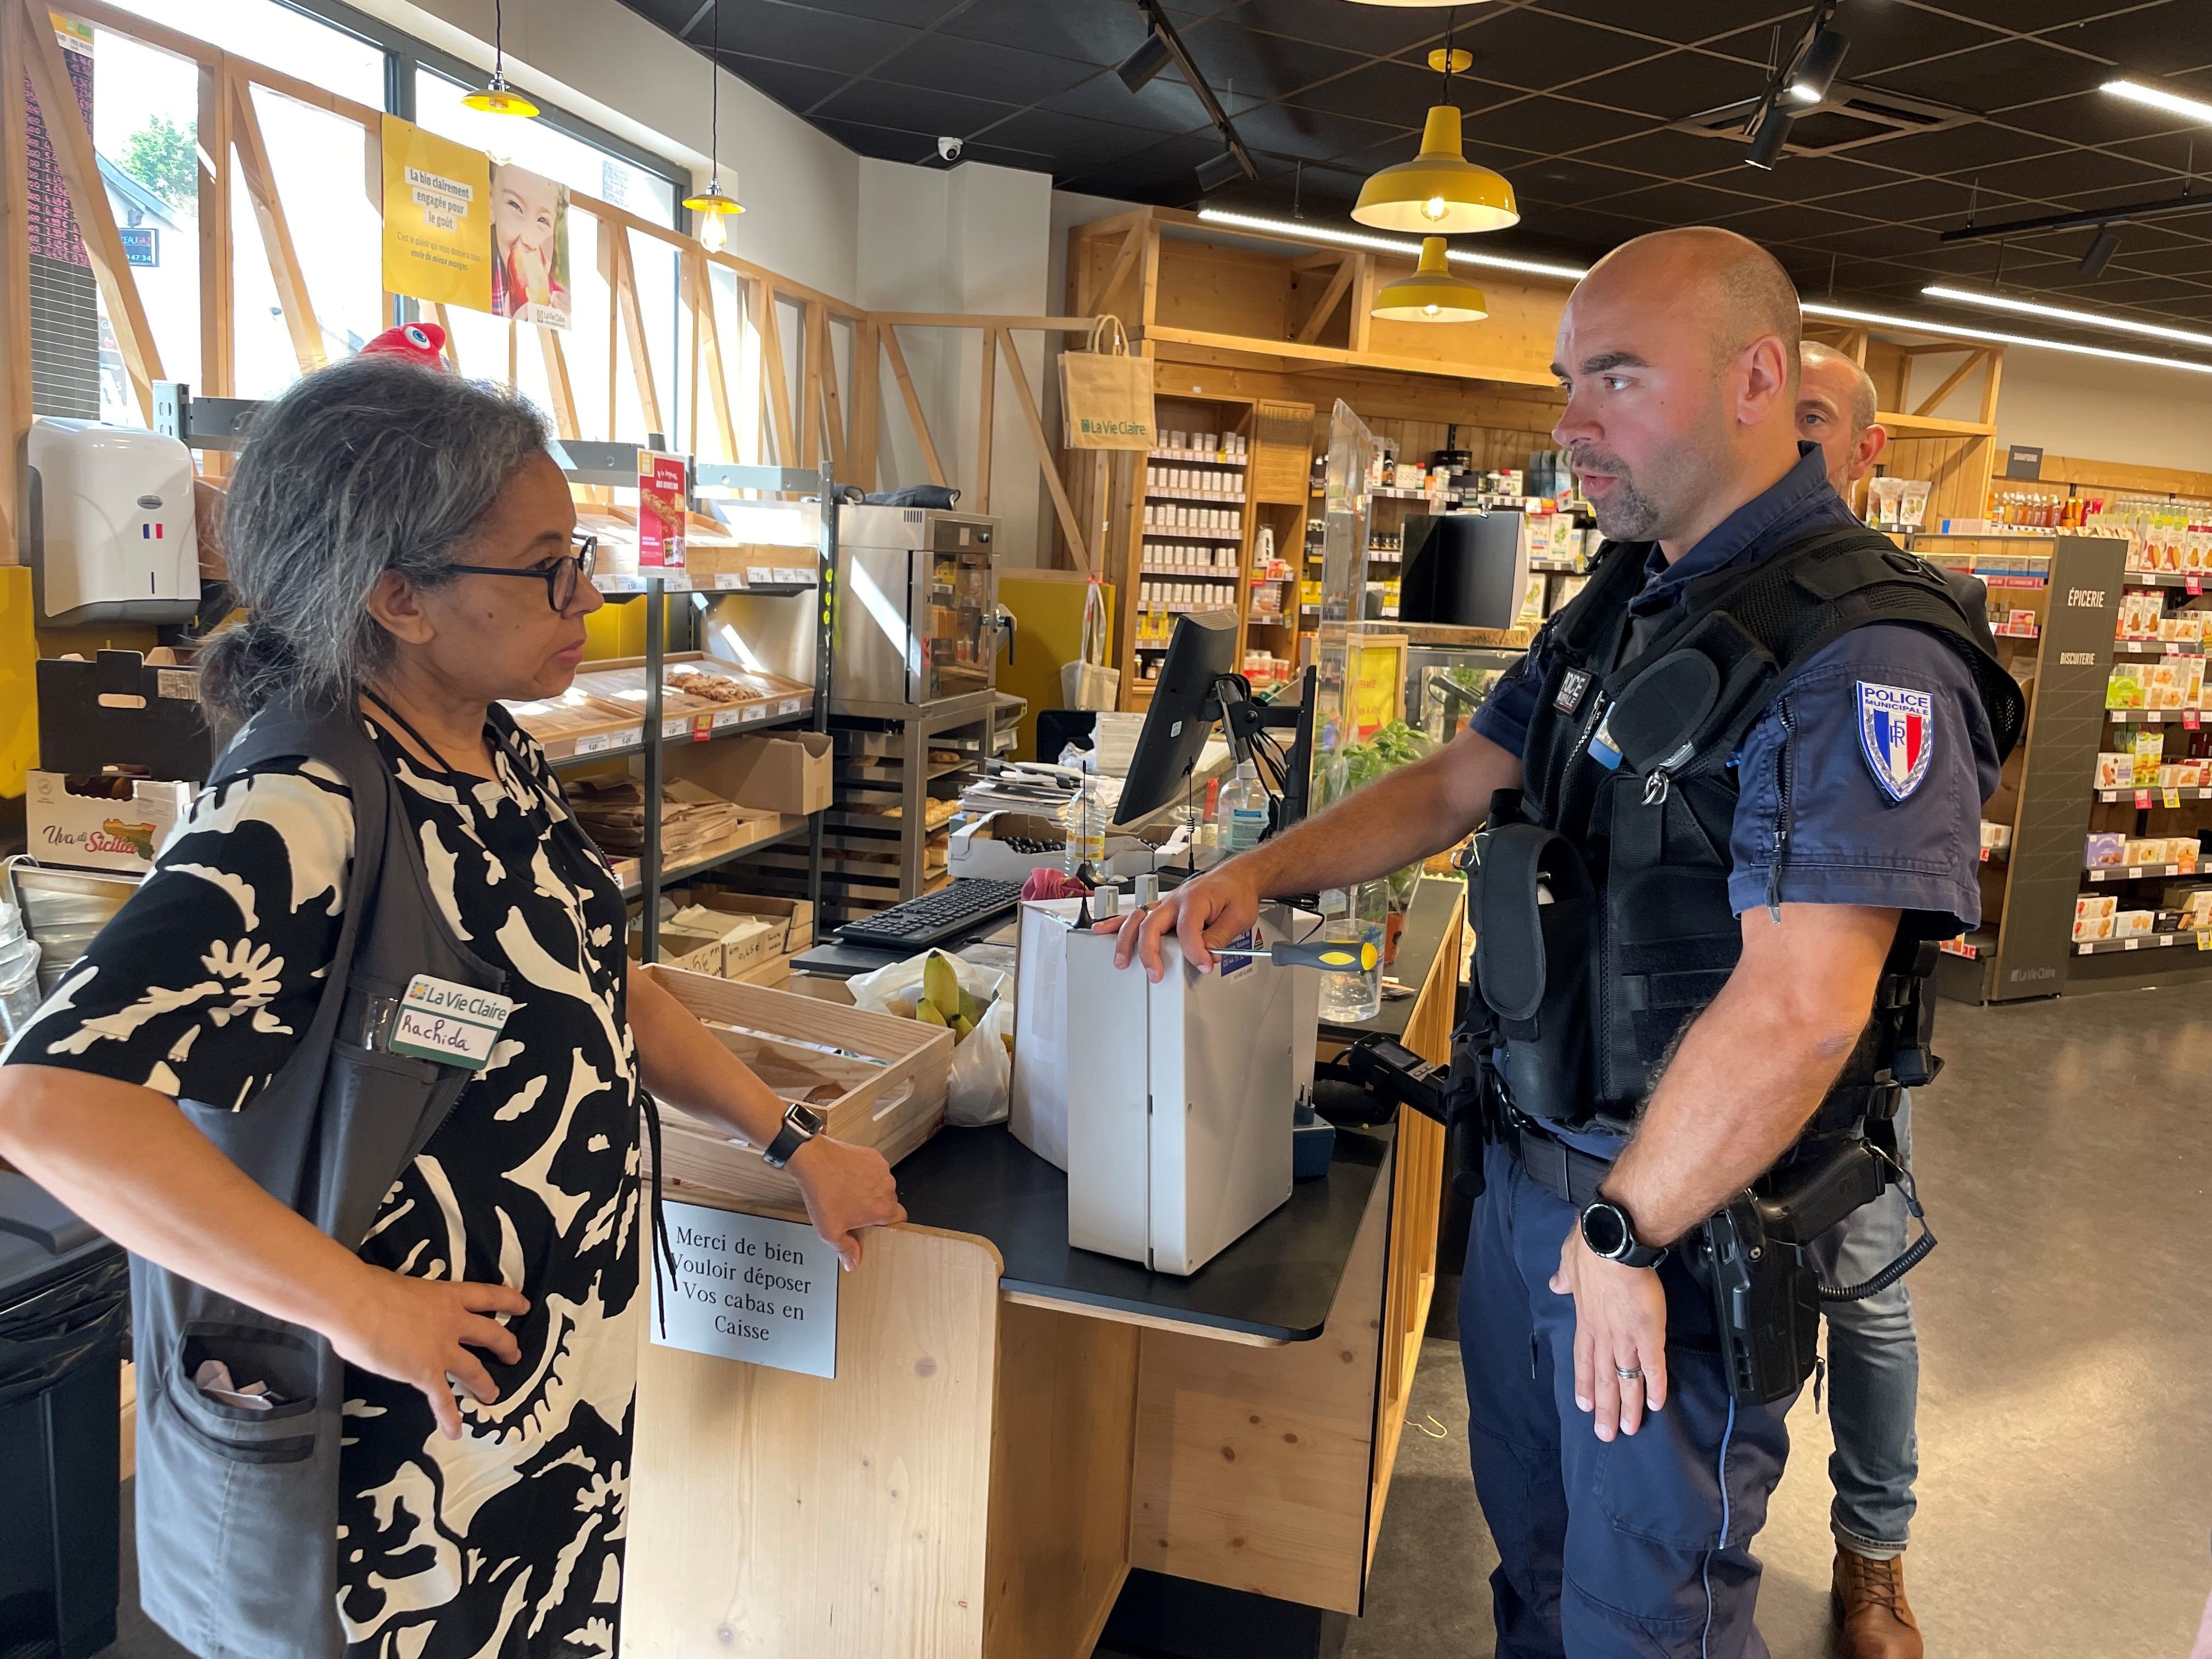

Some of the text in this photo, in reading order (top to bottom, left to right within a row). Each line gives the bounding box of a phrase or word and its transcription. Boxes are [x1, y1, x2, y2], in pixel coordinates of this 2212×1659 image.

[410, 169, 470, 199] La bio clairement
[417, 192, 464, 215] engagée pour
[429, 211, 453, 229] le goût
[411, 250, 425, 259] envie
[425, 252, 431, 261] de
[432, 255, 447, 265] mieux
[1091, 421, 1146, 435] La Vie Claire
[2068, 586, 2105, 608] ÉPICERIE
[2060, 652, 2095, 665] BISCUITERIE
[1865, 687, 1928, 708] POLICE
[1865, 699, 1928, 716] MUNICIPALE
[43, 825, 137, 854] Uva di Sicilia
[426, 987, 507, 1021] La Vie Claire
[676, 1226, 804, 1265] Merci de bien
[744, 1267, 811, 1294] déposer
[682, 1281, 805, 1321] Vos cabas en
[715, 1316, 769, 1341] Caisse
